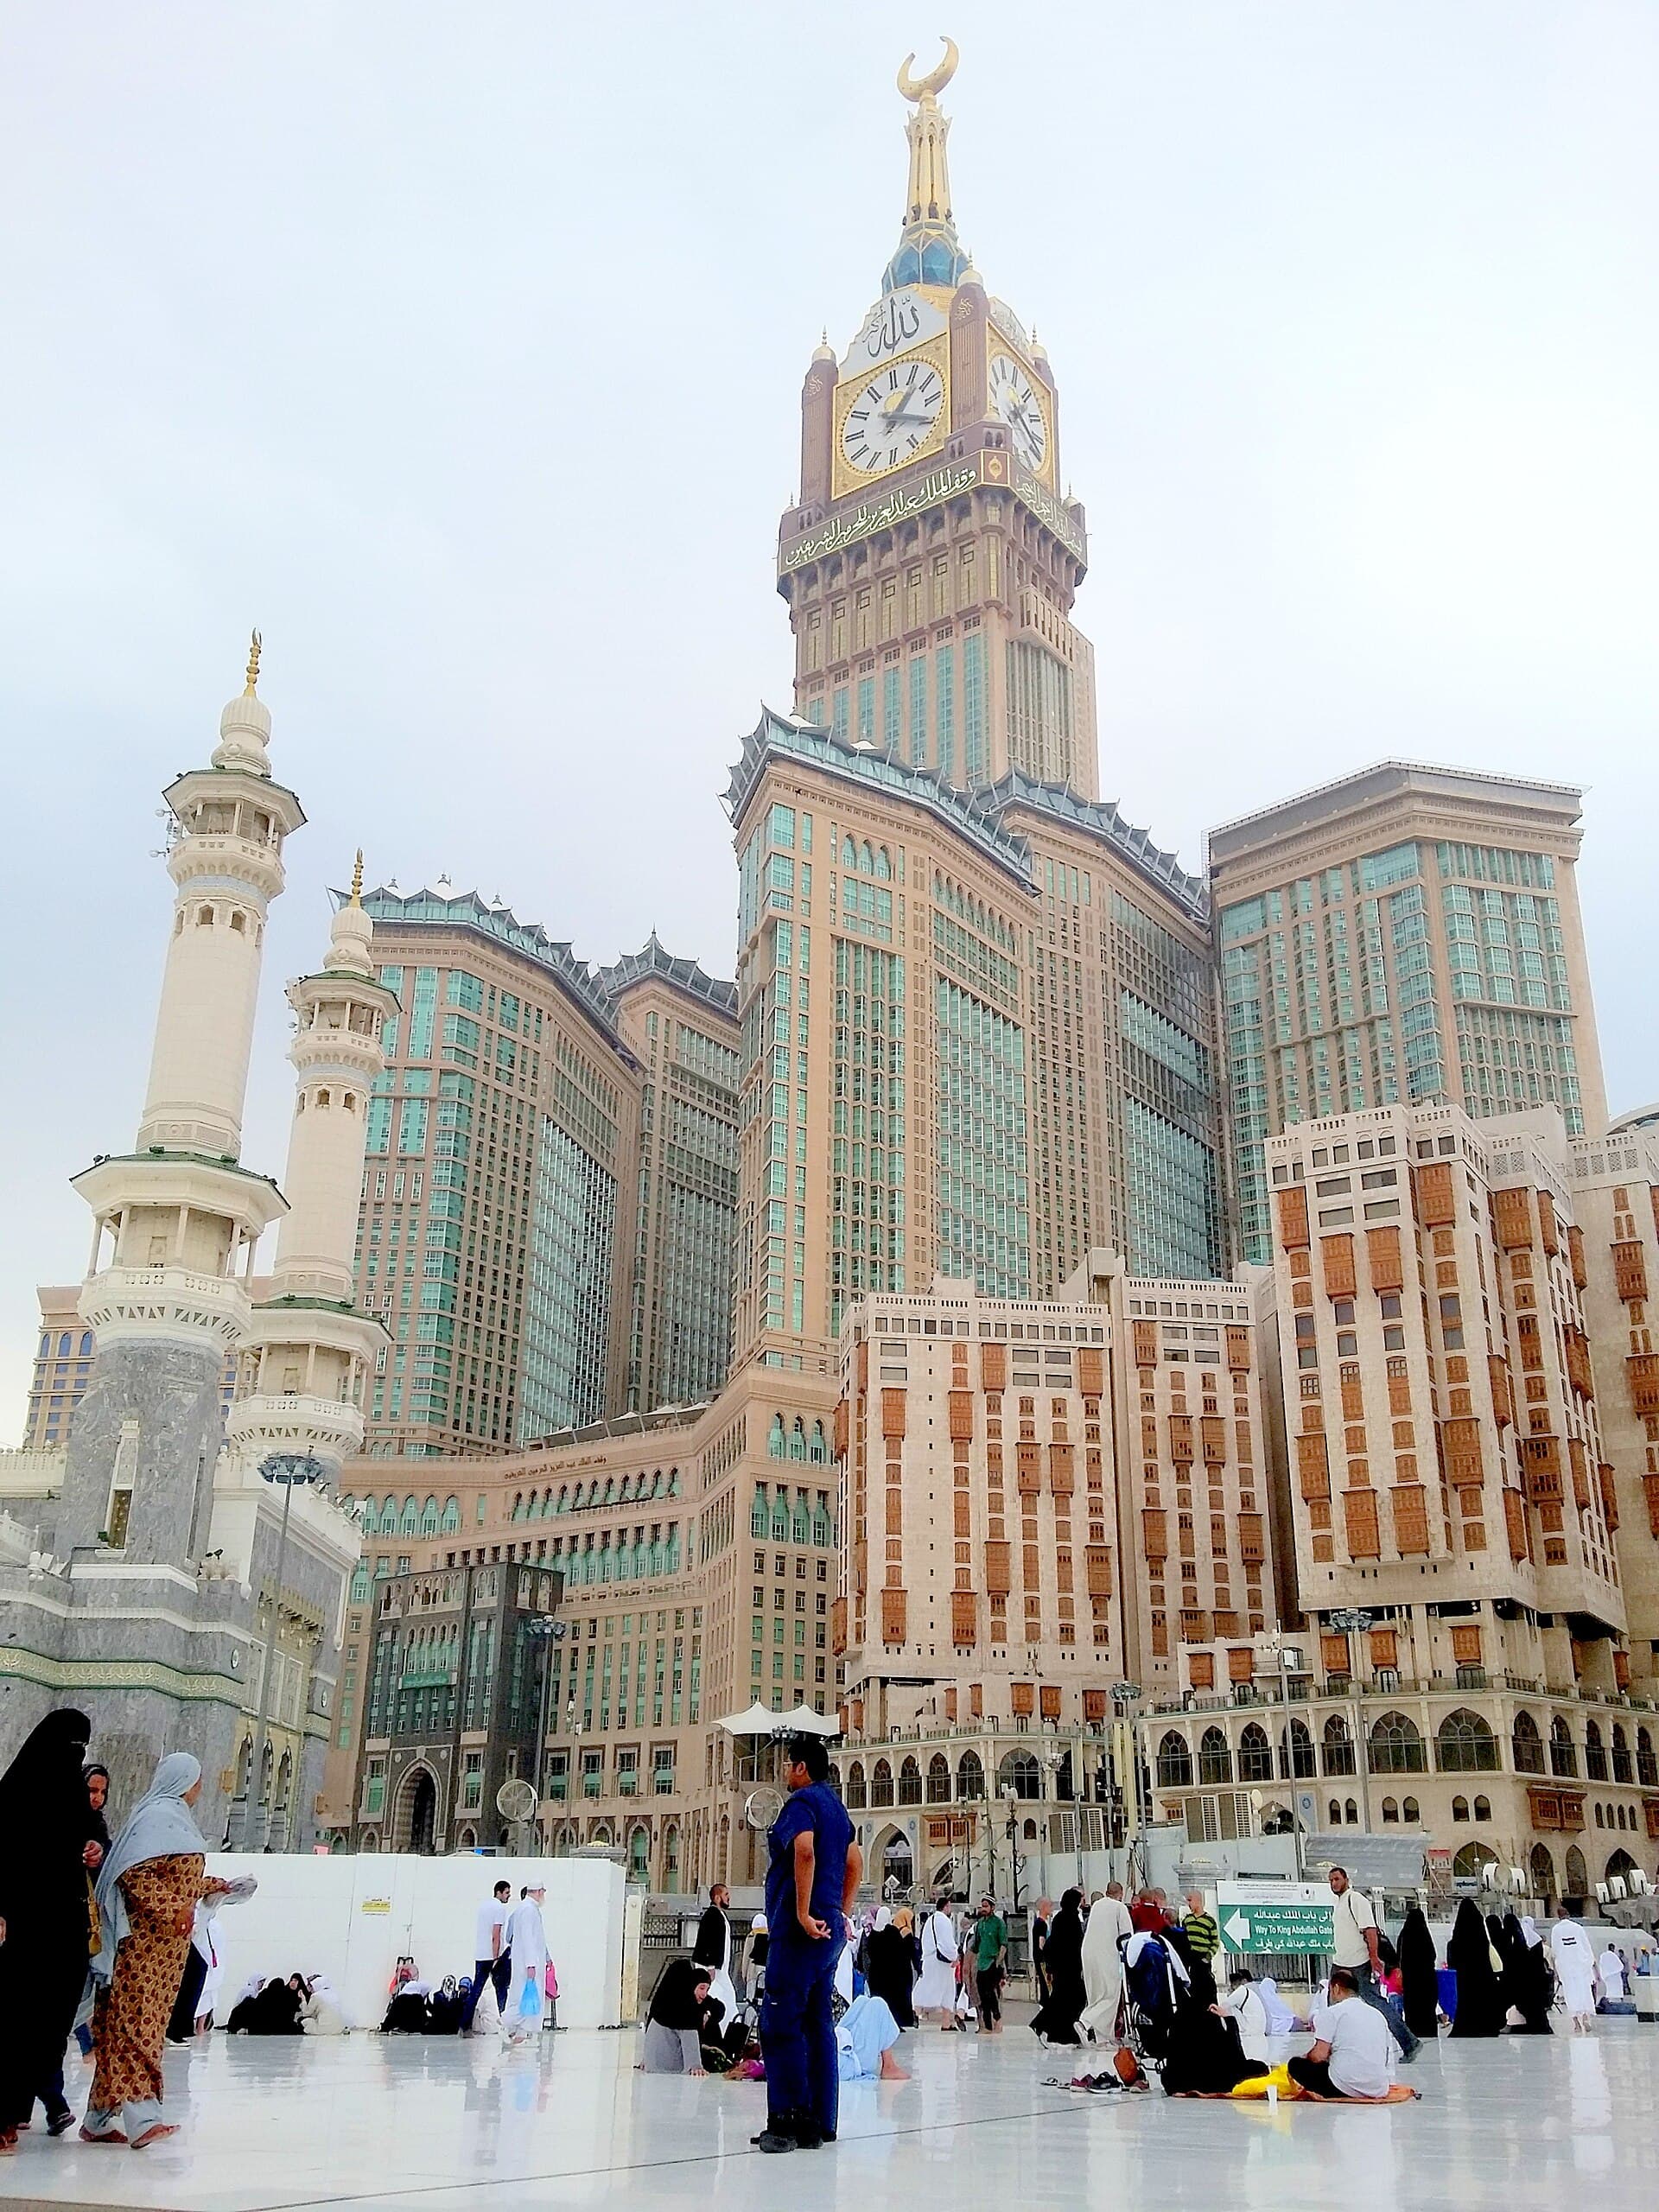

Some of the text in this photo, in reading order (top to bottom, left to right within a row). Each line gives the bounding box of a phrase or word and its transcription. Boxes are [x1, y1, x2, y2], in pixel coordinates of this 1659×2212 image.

[868, 296, 919, 358] الله
[785, 518, 841, 565] الشريفين
[1282, 1910, 1300, 1919] الملك
[1302, 1910, 1317, 1923] باب
[1255, 1924, 1333, 1936] Way To King Abdullah Gate
